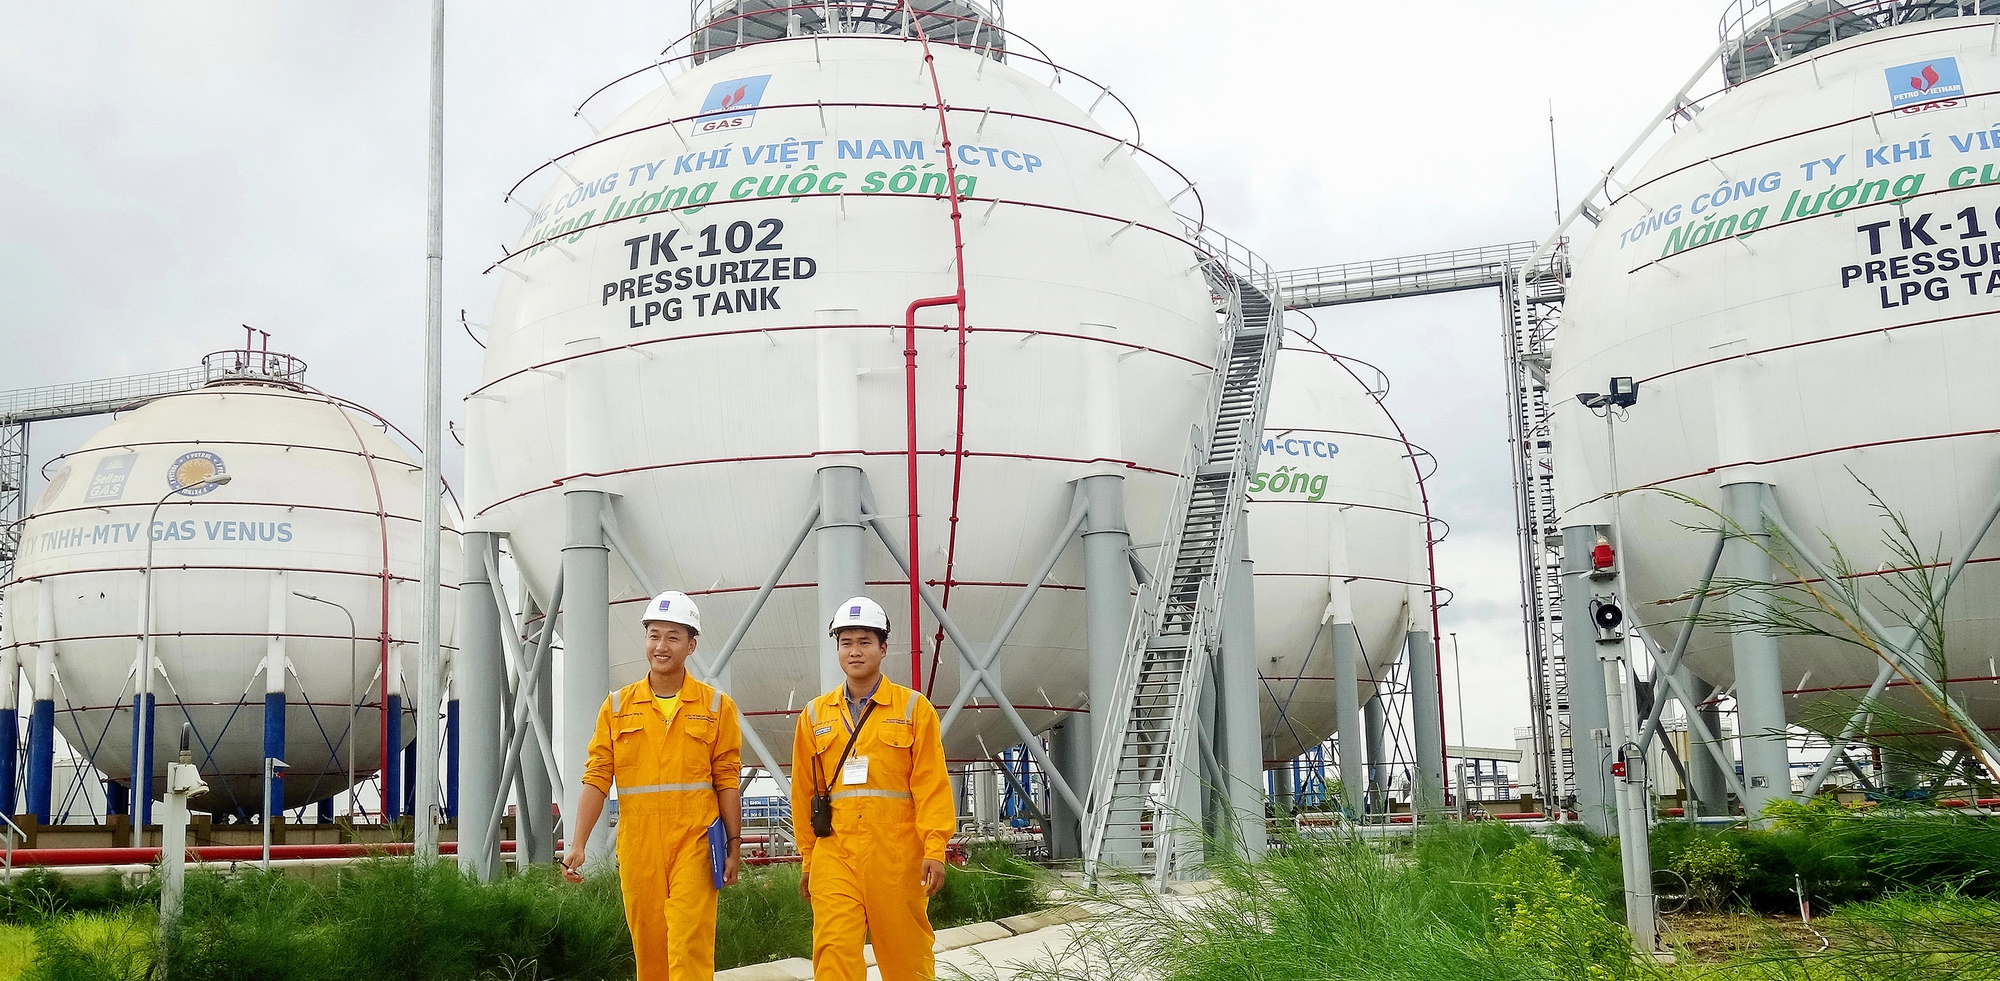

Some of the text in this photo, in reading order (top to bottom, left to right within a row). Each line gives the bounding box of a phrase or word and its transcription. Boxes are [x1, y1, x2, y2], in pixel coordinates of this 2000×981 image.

[703, 118, 743, 131] GAS
[554, 173, 619, 215] CÔNG
[629, 159, 666, 187] TY
[673, 142, 734, 176] KHÍ
[742, 137, 824, 169] VIỆT
[837, 139, 924, 160] NAM
[957, 144, 1043, 173] CTCP
[599, 181, 718, 228] lượng
[729, 164, 847, 203] cuộc
[1691, 171, 1782, 215] CÔNG
[1800, 153, 1847, 181] TY
[1865, 132, 1932, 168] KHÍ
[1661, 205, 1769, 257] Năng
[1780, 173, 1926, 221] lượng
[624, 218, 784, 271] TK-102
[602, 257, 817, 306] PRESSURIZED
[1880, 276, 1949, 309] LPG
[630, 286, 781, 329] LPG TANK
[90, 483, 122, 497] GAS
[1248, 465, 1329, 501] sống
[40, 522, 141, 552] TNHH-MTV
[147, 520, 196, 542] GAS
[204, 521, 293, 542] VENUS
